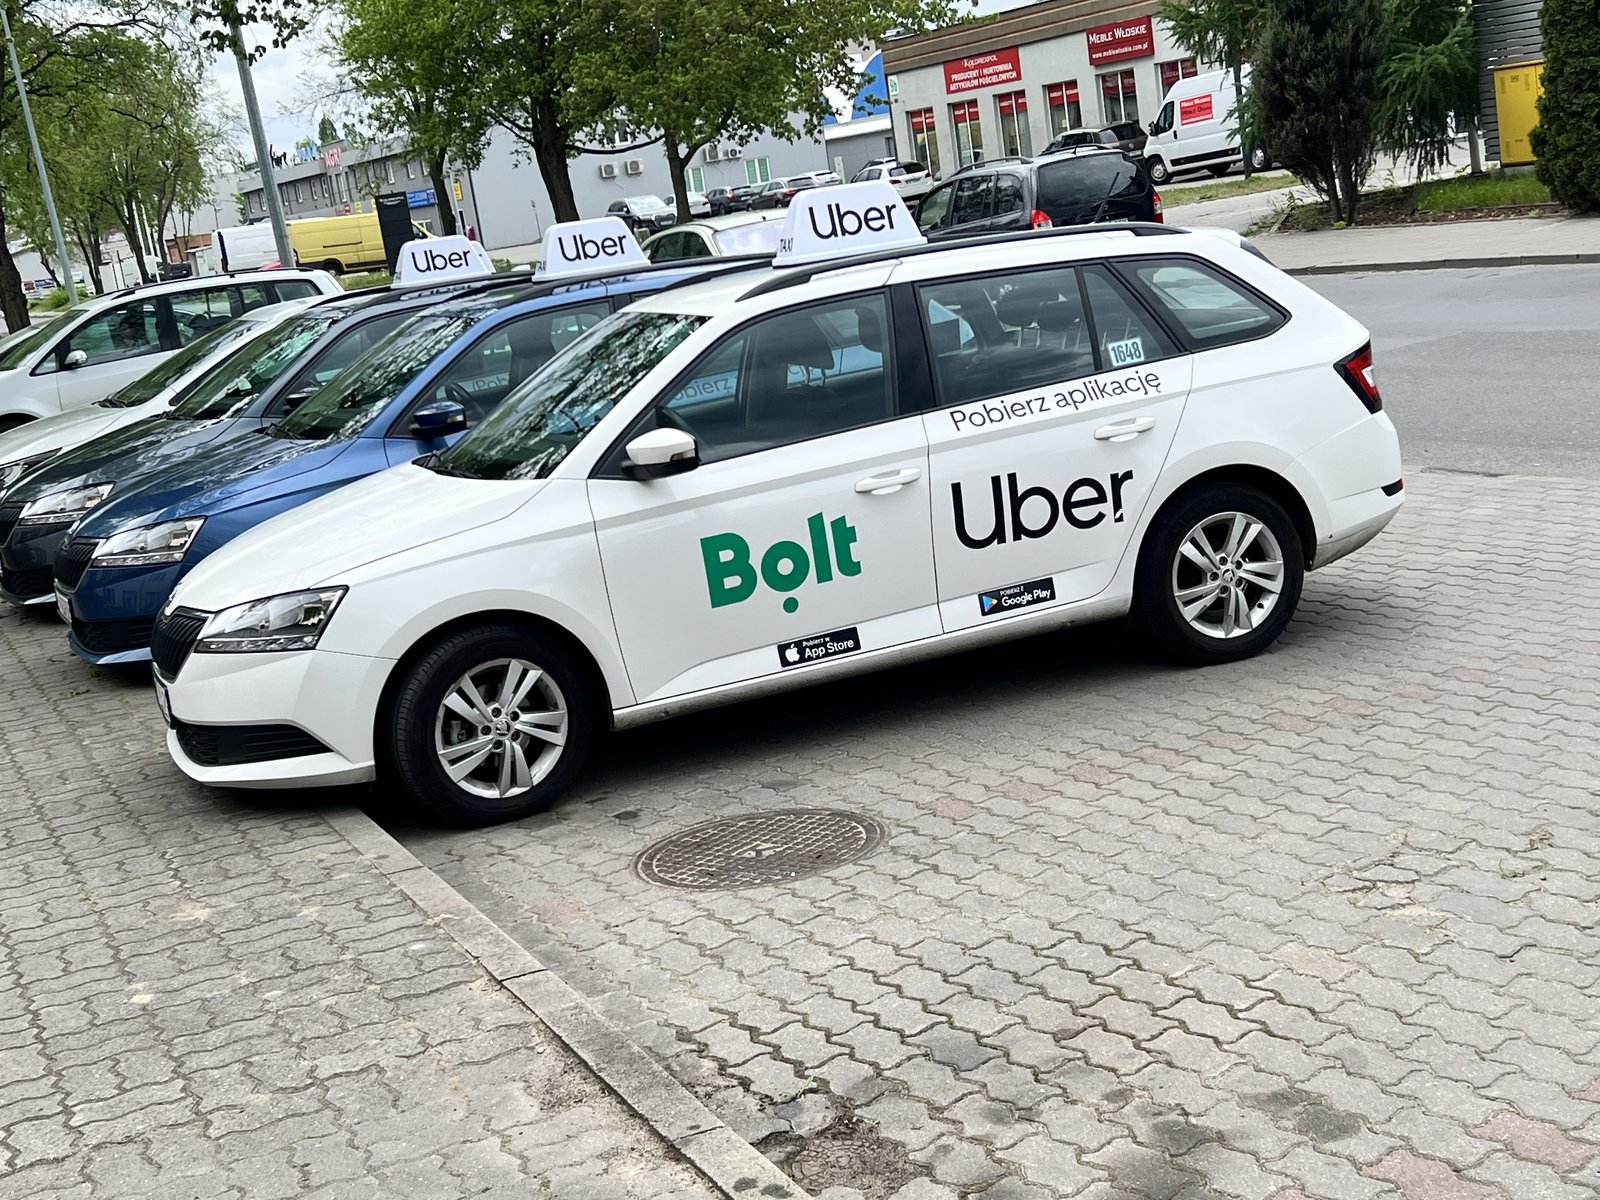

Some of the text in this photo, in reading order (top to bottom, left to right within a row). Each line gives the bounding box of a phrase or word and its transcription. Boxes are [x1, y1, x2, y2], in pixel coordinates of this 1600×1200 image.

[1089, 24, 1147, 45] MEBLE WŁOSKIE
[951, 69, 979, 82] PRODUCENT
[983, 62, 1013, 76] HURTOWNIA
[808, 203, 897, 239] Uber
[558, 234, 626, 262] Uber
[779, 237, 793, 252] TAXI
[411, 249, 471, 273] Uber
[1110, 340, 1142, 364] 1648
[672, 376, 730, 402] obierz
[949, 370, 1162, 432] Pobierz aplikację
[950, 469, 1134, 550] Uber
[700, 511, 862, 614] Bolt
[1001, 588, 1051, 607] Google Play
[802, 638, 824, 648] Pobierz
[804, 639, 855, 659] App Store
